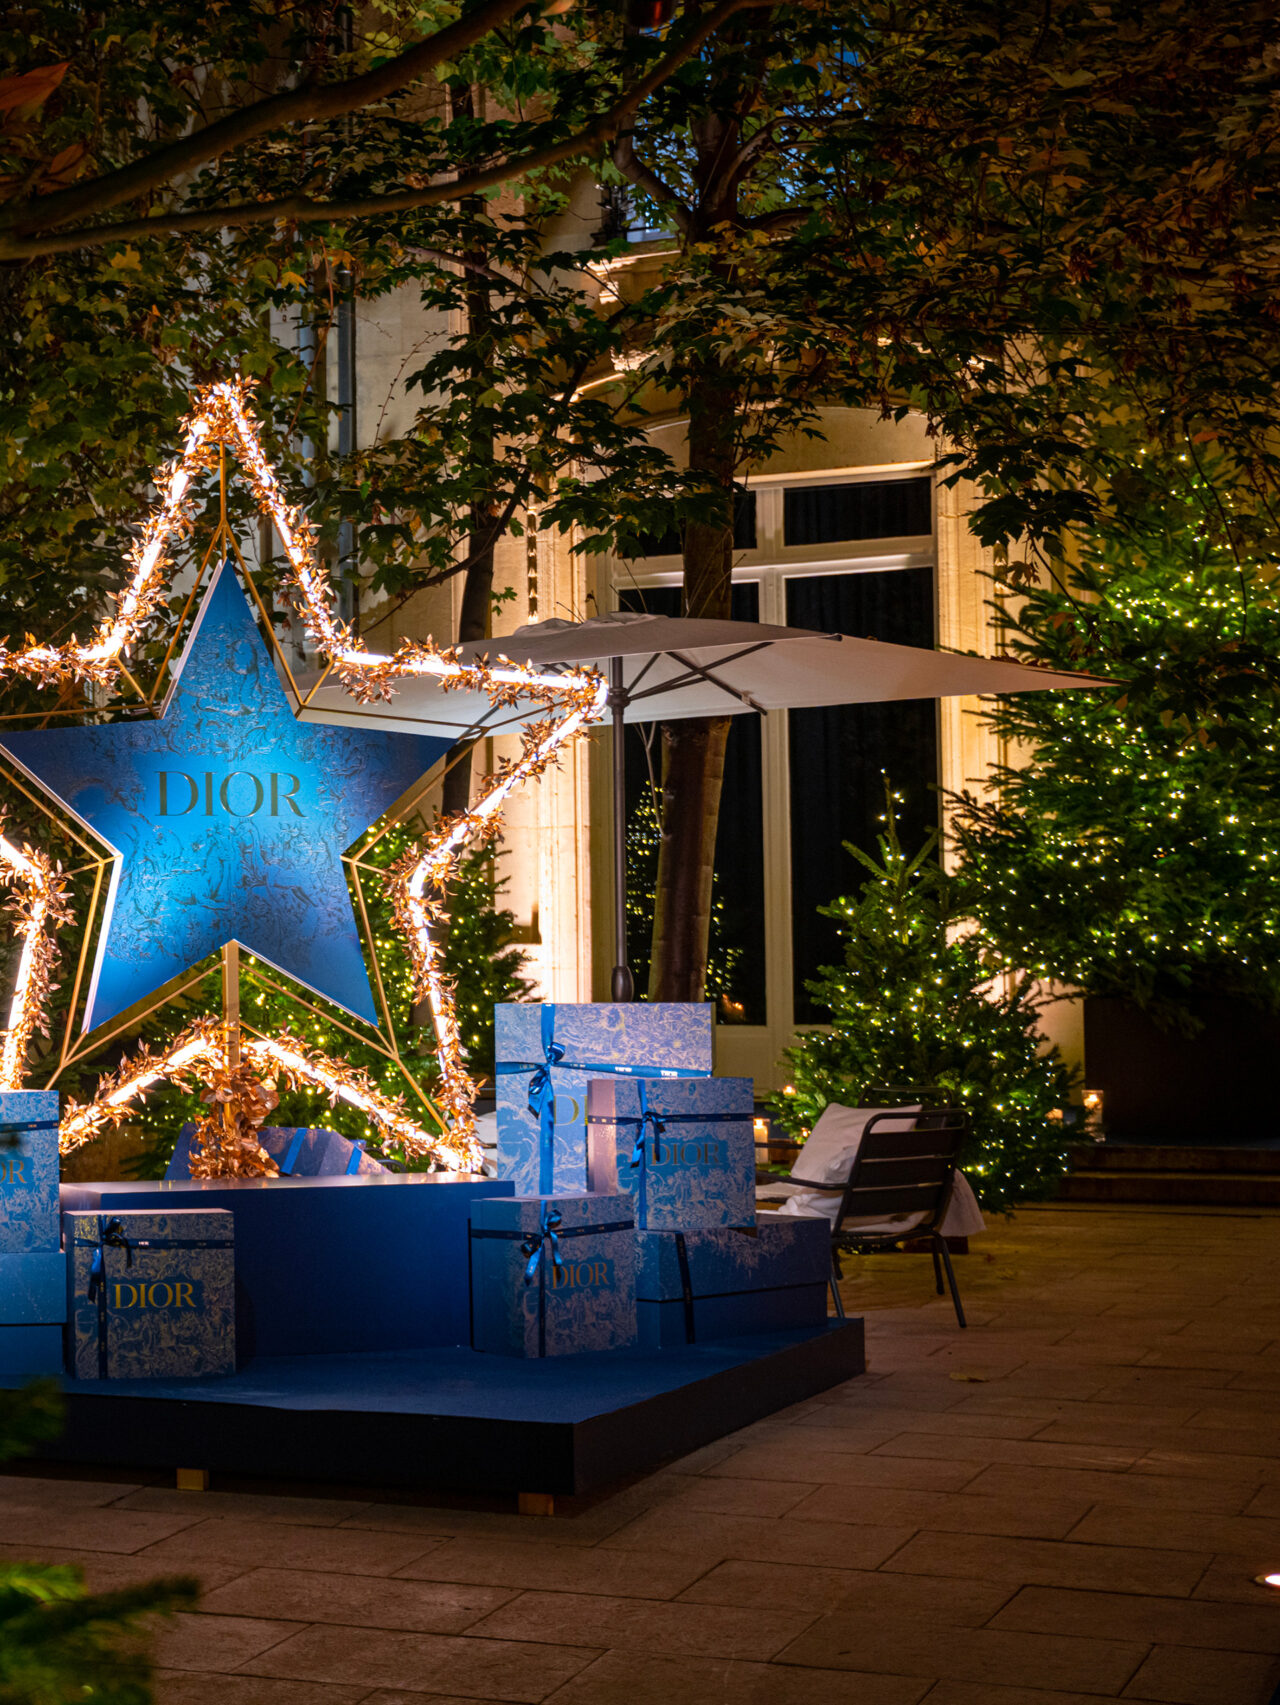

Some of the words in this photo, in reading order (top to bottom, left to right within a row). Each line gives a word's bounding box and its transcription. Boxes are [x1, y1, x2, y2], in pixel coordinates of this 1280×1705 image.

[154, 770, 308, 818] DIOR
[649, 1142, 724, 1167] DIOR
[551, 1262, 610, 1290] DIOR
[112, 1281, 198, 1309] DIOR
